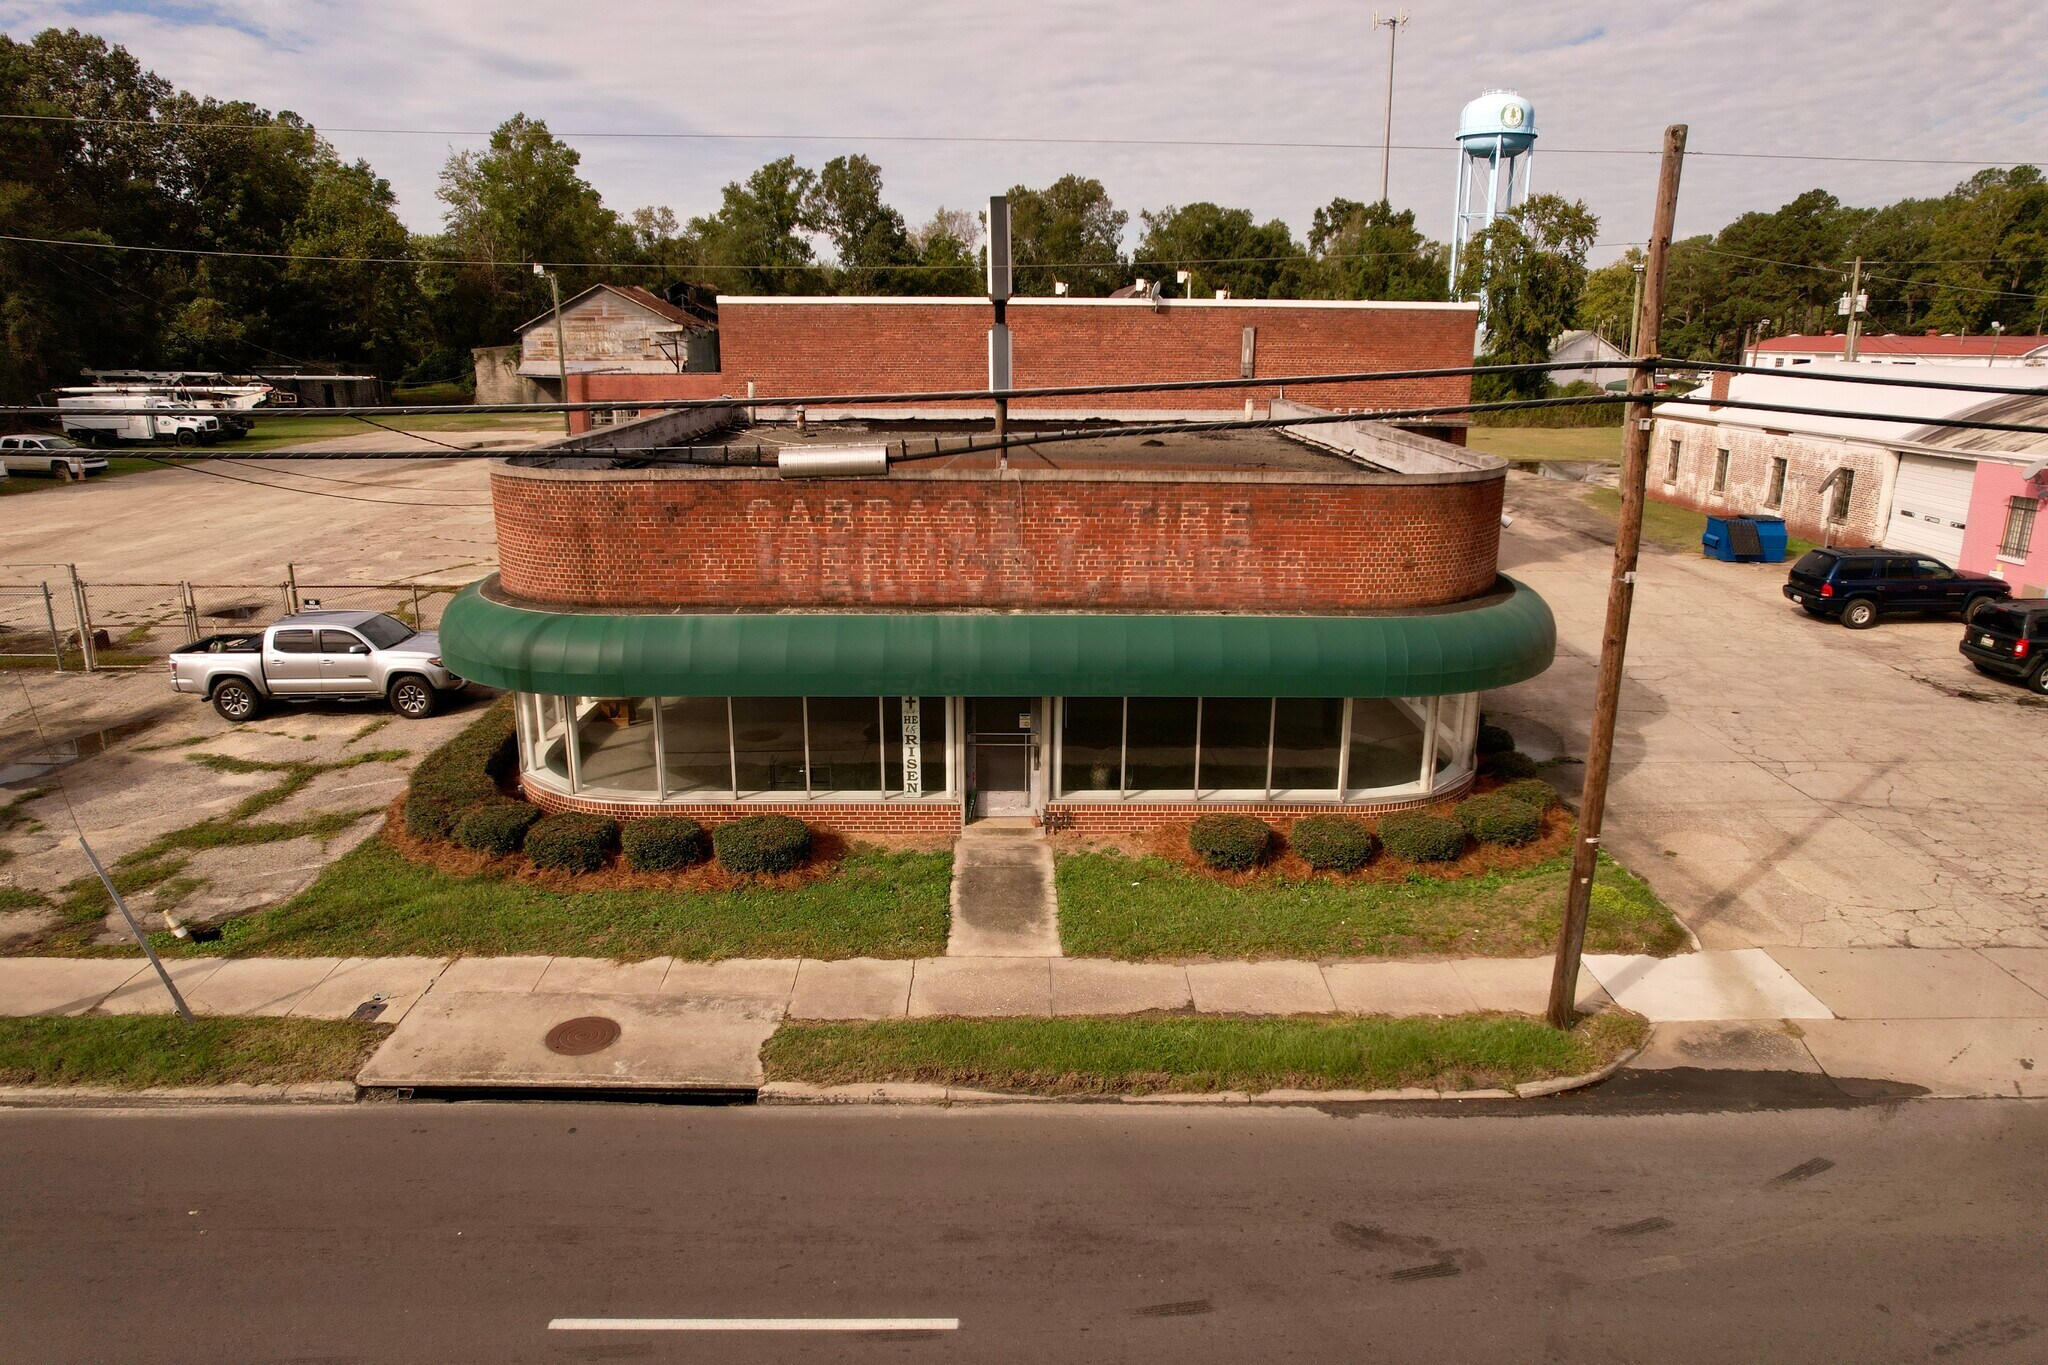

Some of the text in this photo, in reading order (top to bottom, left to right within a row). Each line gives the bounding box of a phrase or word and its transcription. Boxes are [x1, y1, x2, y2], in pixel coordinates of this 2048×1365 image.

[903, 715, 919, 724] HE
[905, 724, 918, 734] is
[904, 734, 919, 793] RISEN
